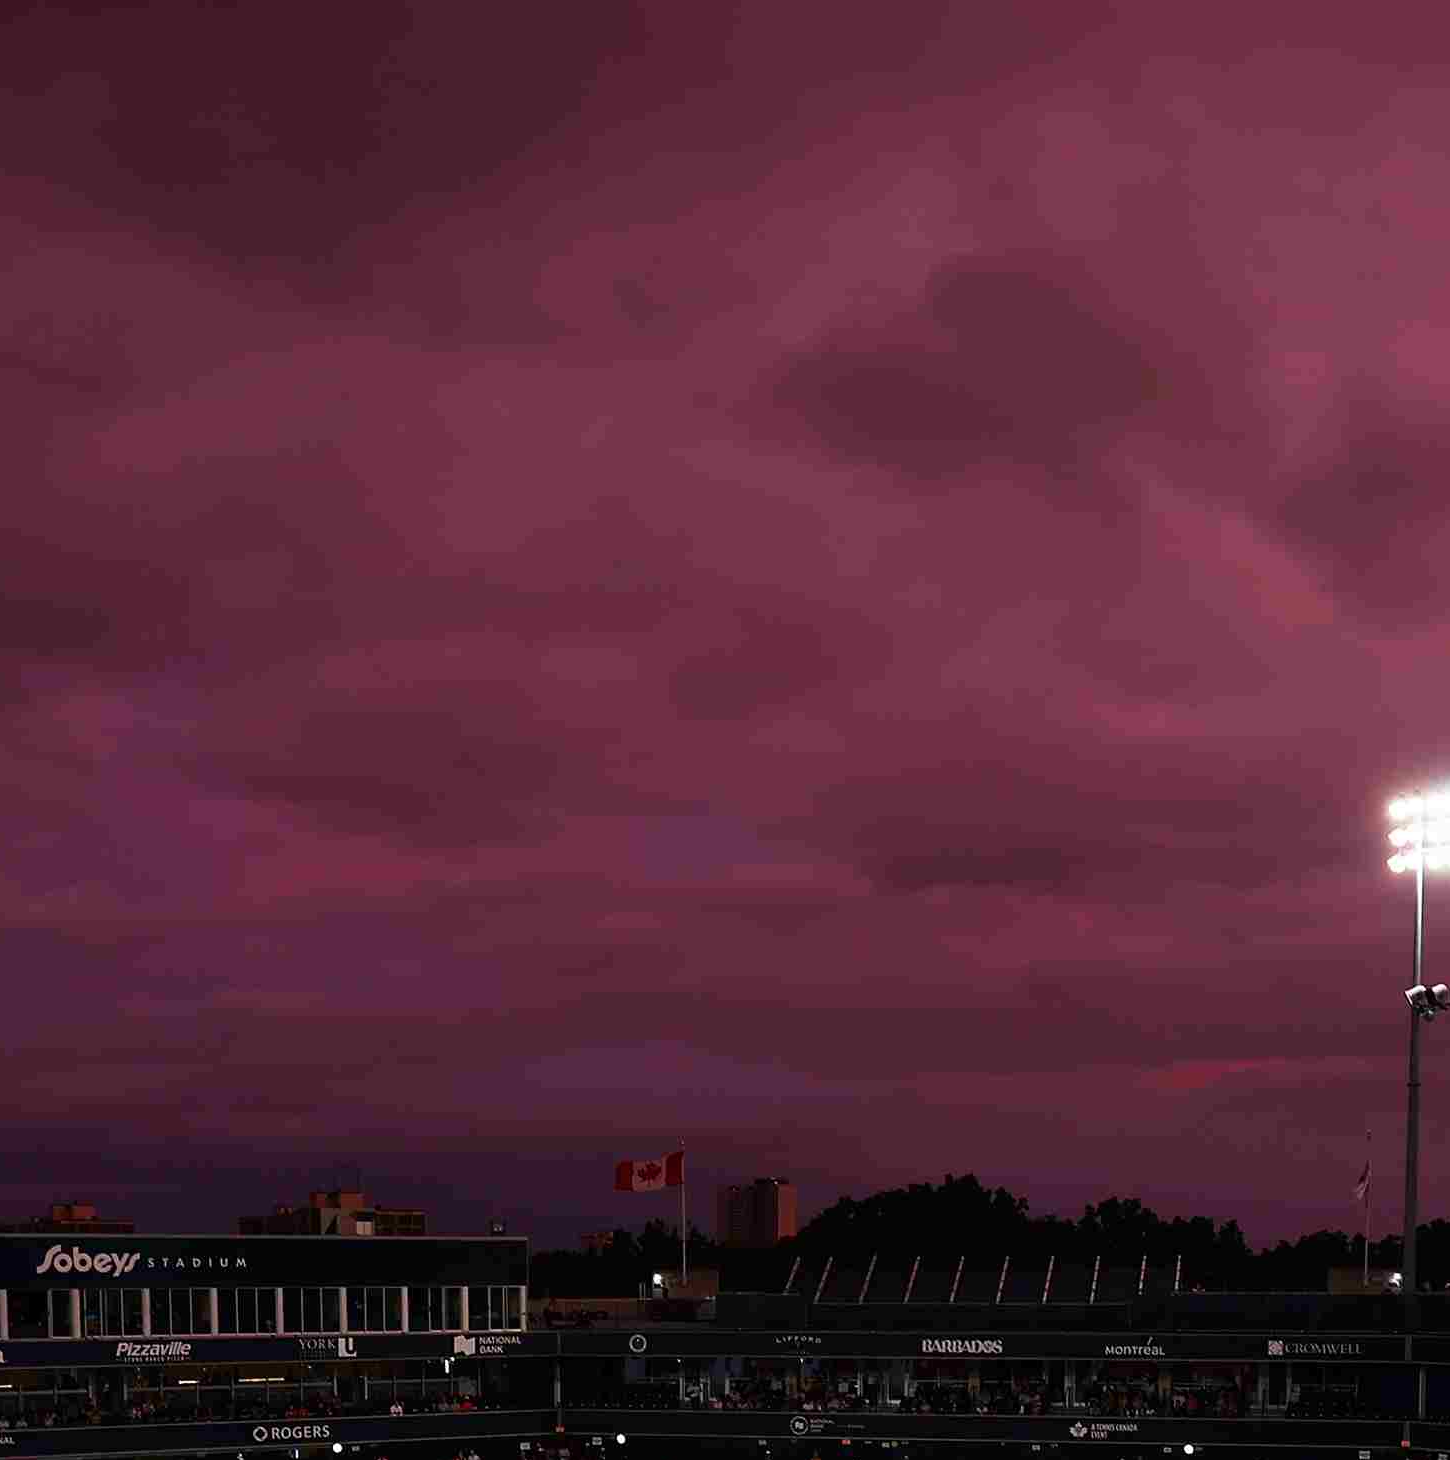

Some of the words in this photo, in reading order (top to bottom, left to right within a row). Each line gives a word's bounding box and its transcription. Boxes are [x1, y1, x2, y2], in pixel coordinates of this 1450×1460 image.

[37, 1244, 141, 1278] Sobeys
[148, 1256, 247, 1269] STADIUM
[298, 1338, 336, 1350] YORK
[479, 1336, 522, 1345] NATIONAL
[921, 1338, 1004, 1354] BARBADOS
[116, 1341, 192, 1357] Pizzaville
[479, 1345, 504, 1354] BANK
[1284, 1343, 1364, 1355] CROMWELL
[271, 1425, 330, 1440] ROGERS
